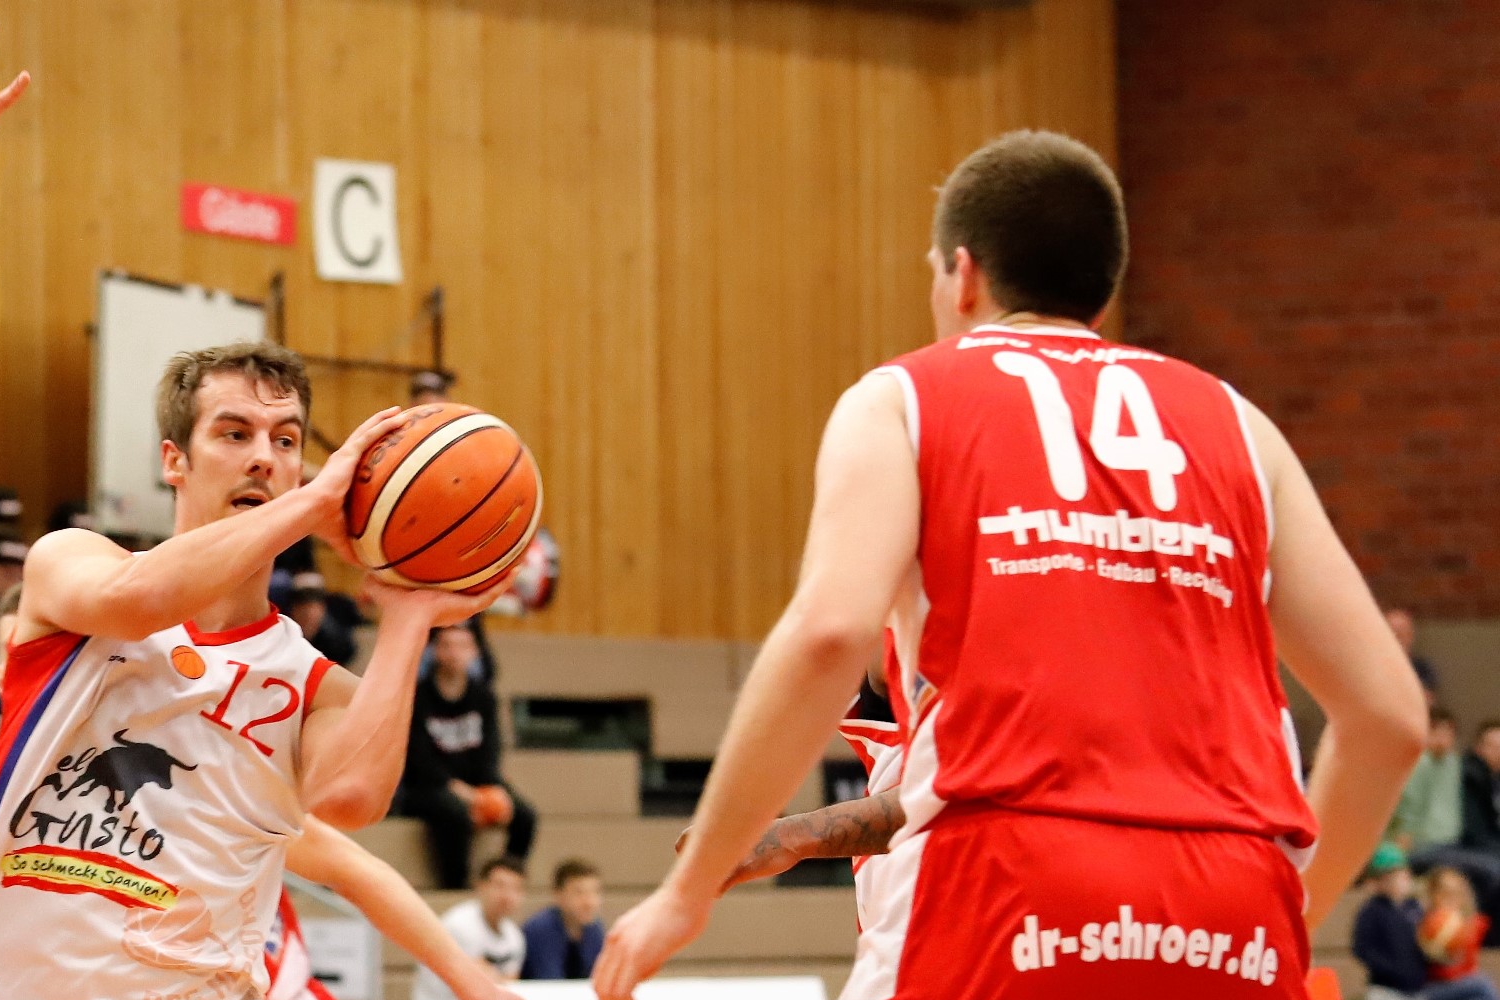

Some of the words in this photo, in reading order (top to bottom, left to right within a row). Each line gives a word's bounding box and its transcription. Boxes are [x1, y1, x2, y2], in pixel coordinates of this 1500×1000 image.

[330, 173, 384, 268] C
[992, 351, 1187, 512] 14
[987, 553, 1085, 576] Transporte
[201, 659, 301, 757] 12
[57, 747, 97, 772] el
[9, 772, 165, 861] Gusto
[10, 855, 27, 871] So
[30, 857, 98, 879] schmeckt
[100, 869, 169, 902] Spanien!
[1011, 904, 1279, 987] dr-schroer.de
